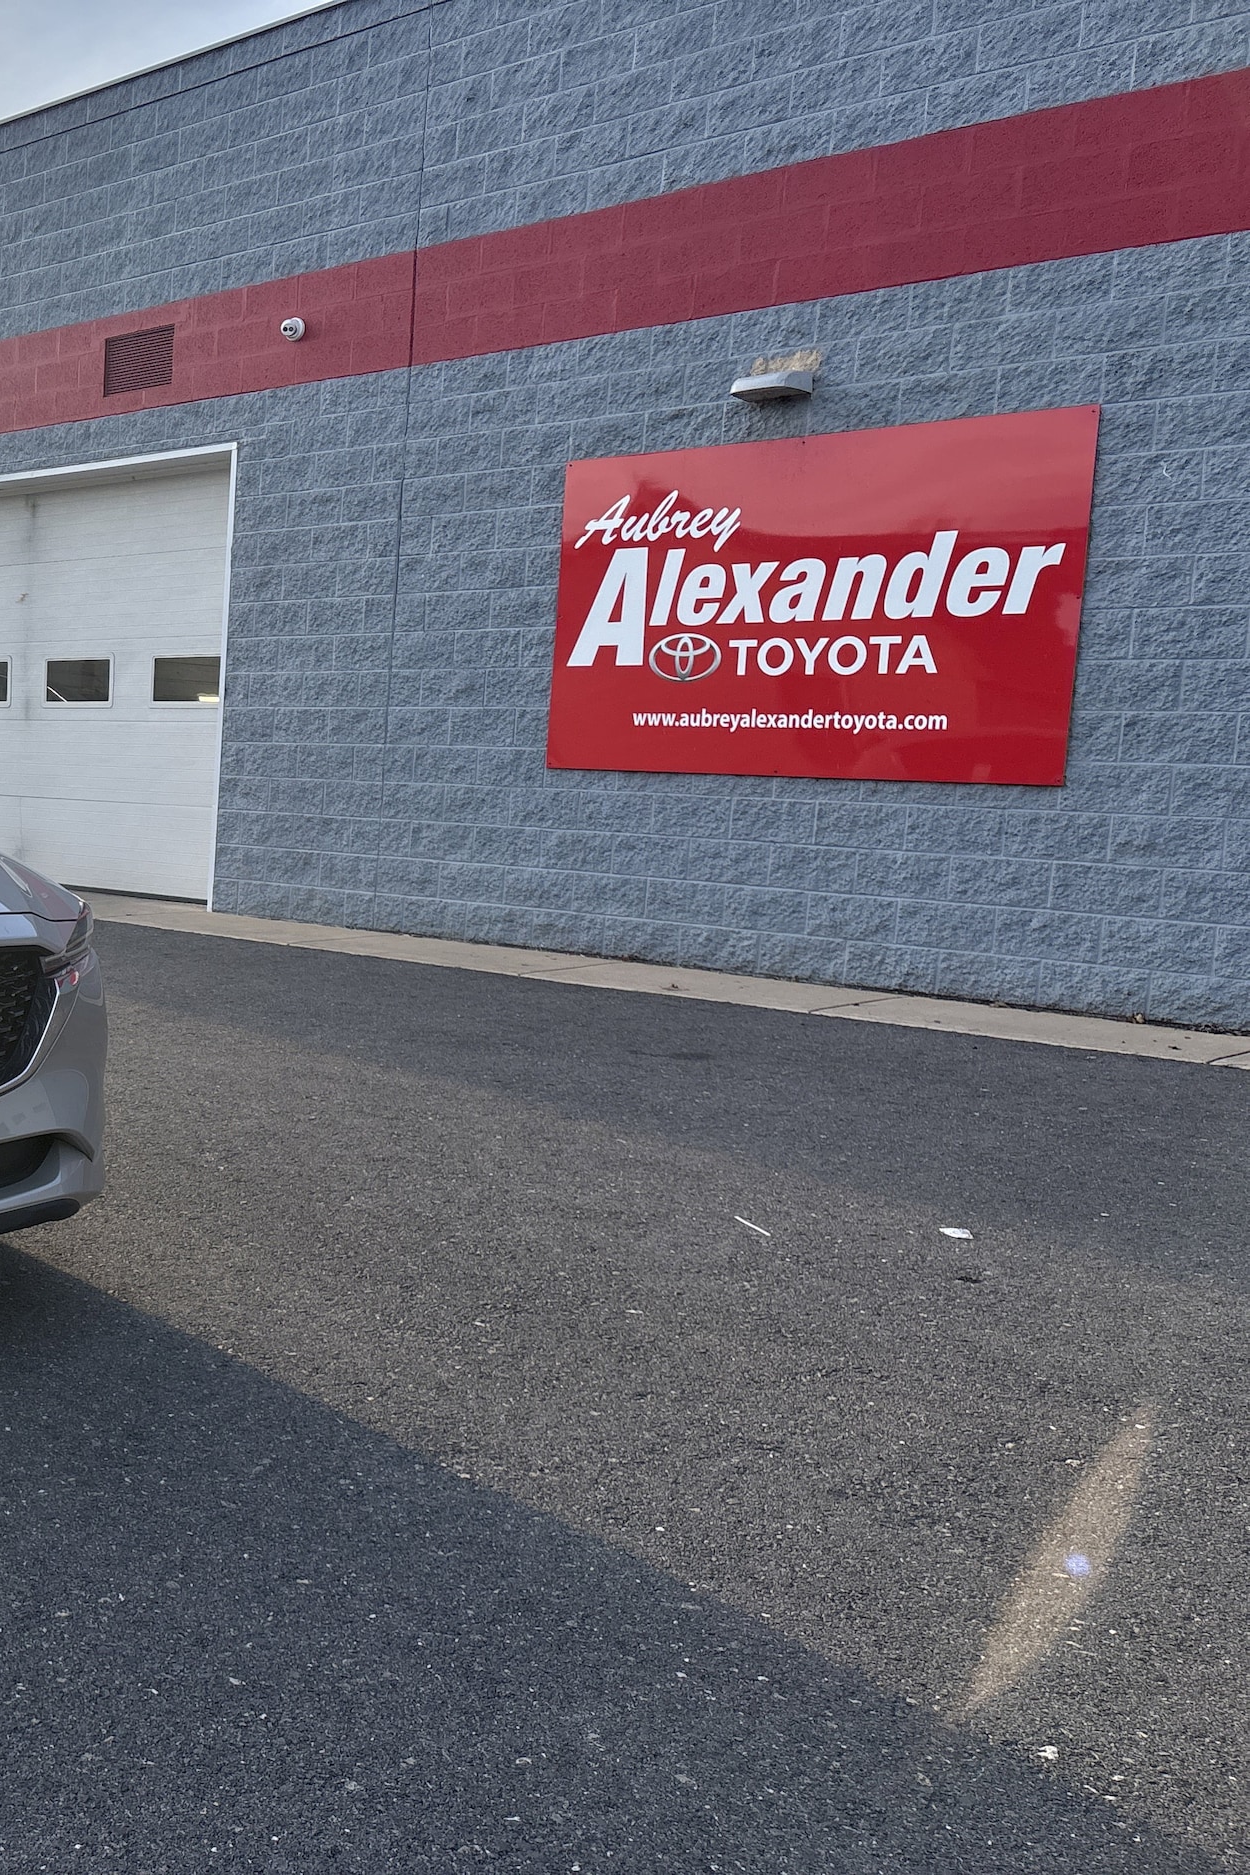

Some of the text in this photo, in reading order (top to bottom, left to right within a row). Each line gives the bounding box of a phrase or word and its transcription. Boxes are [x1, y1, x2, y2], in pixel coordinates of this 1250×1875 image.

[575, 489, 741, 553] Aubrey
[566, 531, 1066, 667] Alexander
[728, 634, 938, 676] TOYOTA
[632, 708, 948, 735] www.aubreyalexandertoyota.com
